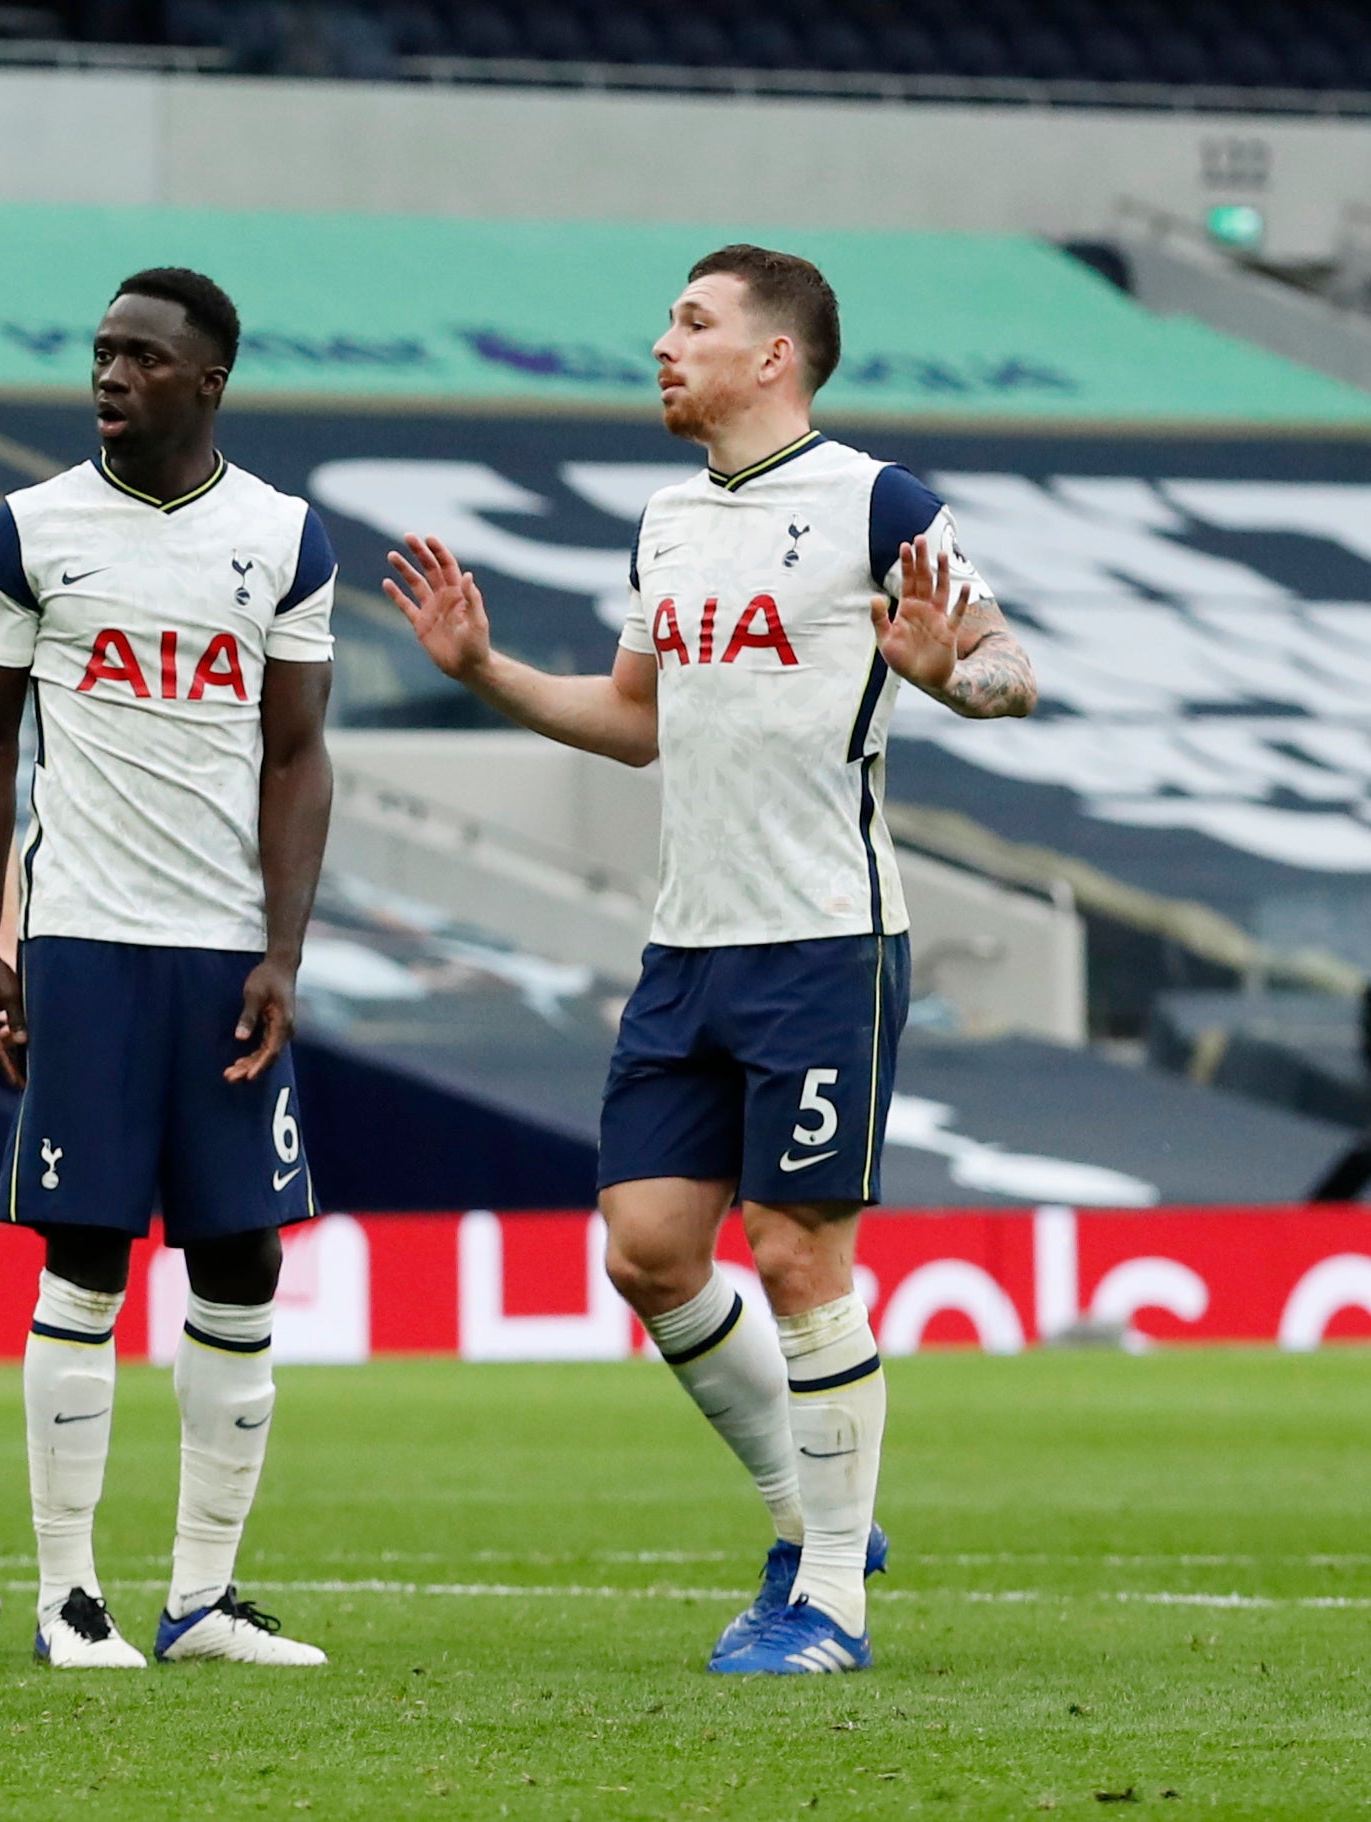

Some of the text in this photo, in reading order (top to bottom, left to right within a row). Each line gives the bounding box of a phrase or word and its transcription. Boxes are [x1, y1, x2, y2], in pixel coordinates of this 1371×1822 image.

[76, 628, 248, 701] AIA
[652, 594, 799, 670] AIA
[272, 1086, 299, 1164] 6
[792, 1068, 838, 1146] 5
